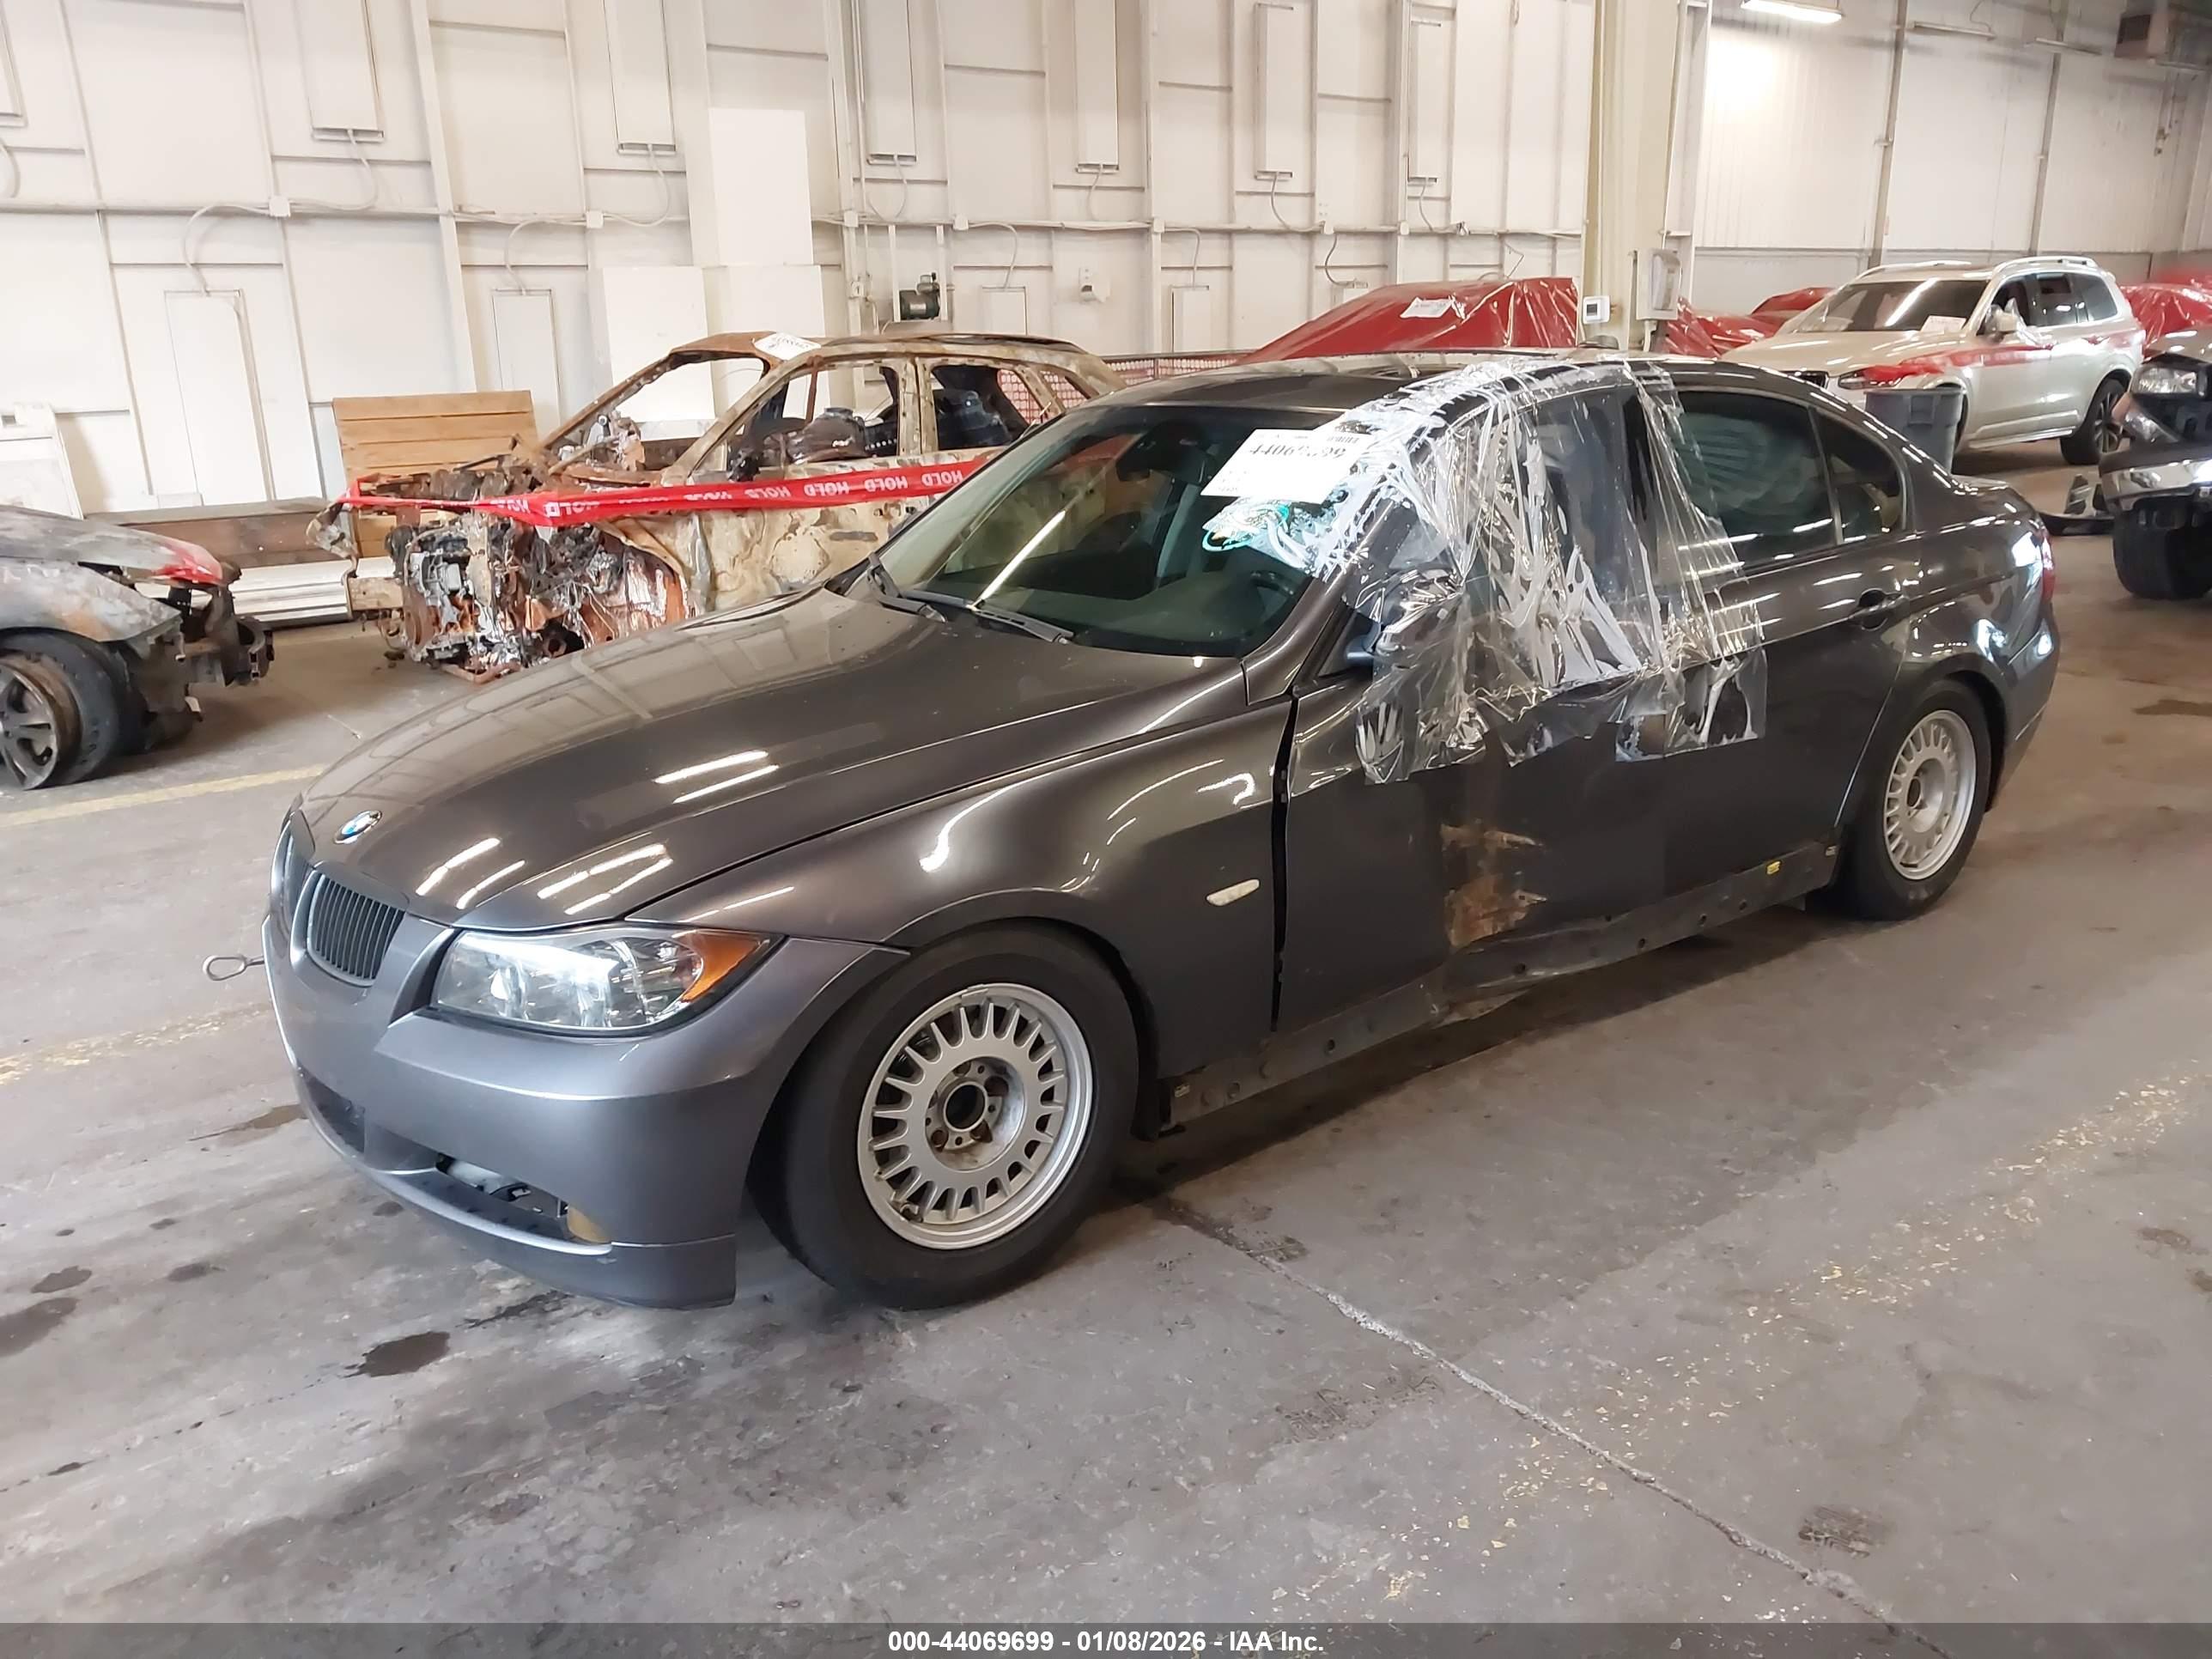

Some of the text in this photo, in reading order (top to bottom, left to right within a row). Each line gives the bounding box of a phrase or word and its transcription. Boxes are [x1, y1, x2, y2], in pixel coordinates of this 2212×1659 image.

[864, 476, 908, 492] HOLD
[921, 470, 963, 487] HOLD
[744, 486, 791, 499] HOLD
[803, 480, 850, 496] HOLD
